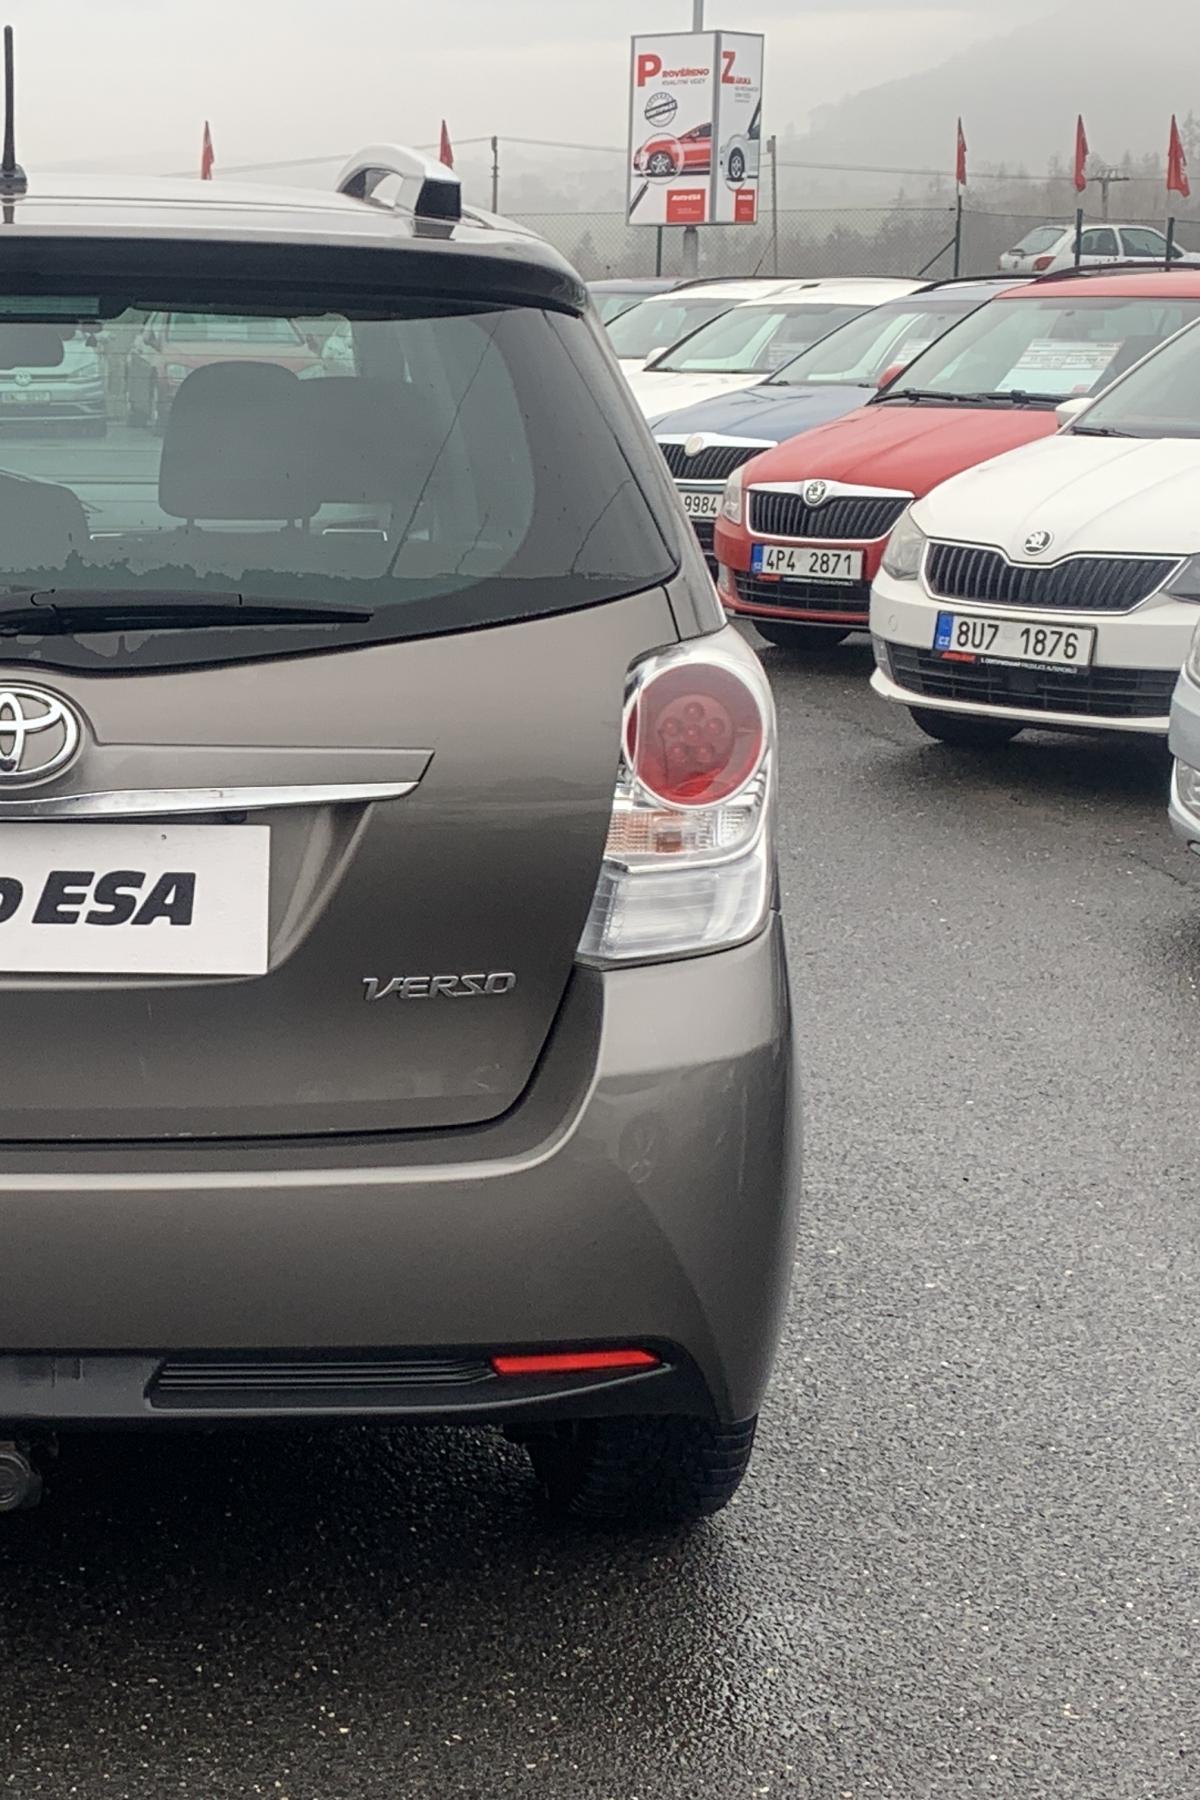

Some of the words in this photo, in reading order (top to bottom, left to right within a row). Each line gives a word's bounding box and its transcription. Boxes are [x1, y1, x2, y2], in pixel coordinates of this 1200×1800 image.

[684, 495, 717, 514] 9984
[766, 549, 796, 572] 4P4
[808, 552, 852, 576] 2871
[938, 636, 950, 645] CZ
[956, 621, 999, 650] 8U7
[1020, 627, 1079, 660] 1876
[31, 869, 197, 927] ESA
[362, 972, 517, 1001] VERSO
